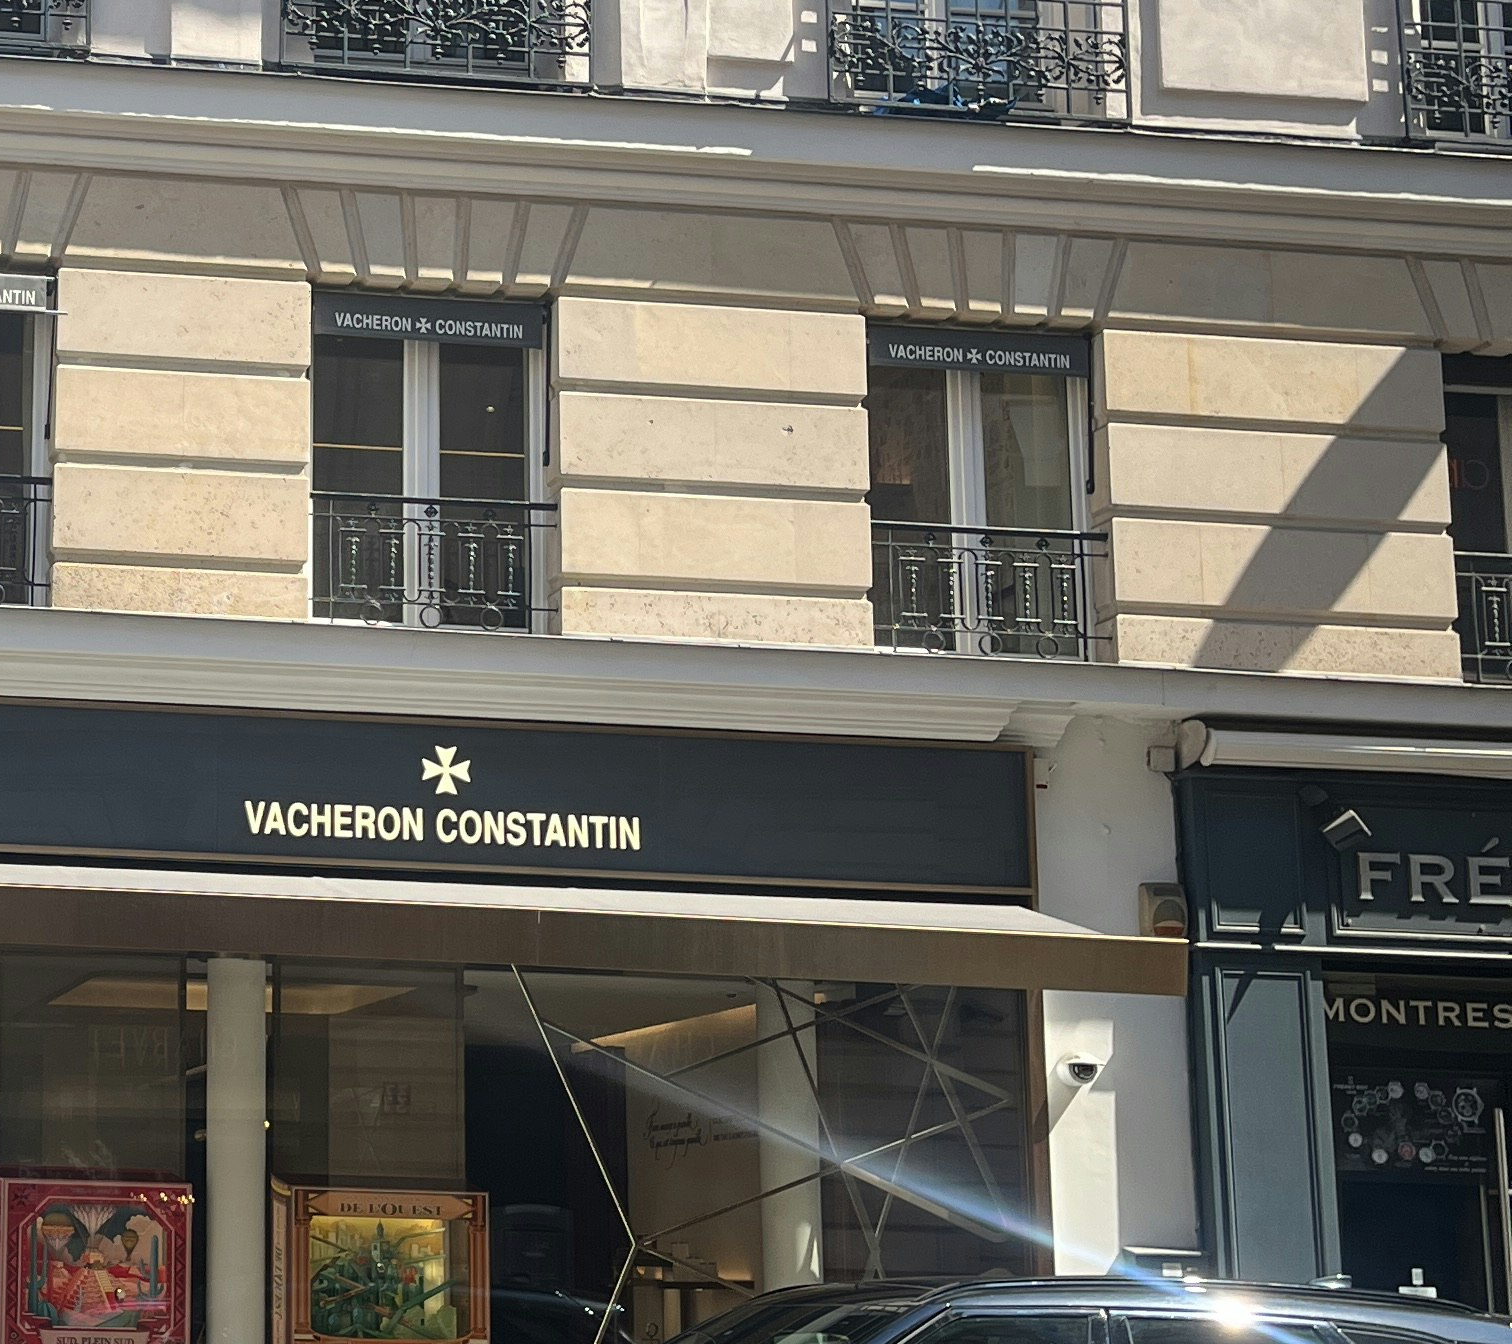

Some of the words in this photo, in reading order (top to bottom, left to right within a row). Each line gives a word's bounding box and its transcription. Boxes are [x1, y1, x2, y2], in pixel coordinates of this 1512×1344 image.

[334, 311, 412, 332] VACHERON
[436, 319, 523, 339] CONSTANTIN
[888, 343, 963, 362] VACHERON
[986, 349, 1070, 369] CONSTANTIN
[244, 800, 424, 842] VACHERON
[435, 808, 641, 851] CONSTANTIN
[1357, 837, 1512, 906] FRÉ
[1322, 997, 1512, 1030] MONTRES
[340, 1202, 363, 1213] DE
